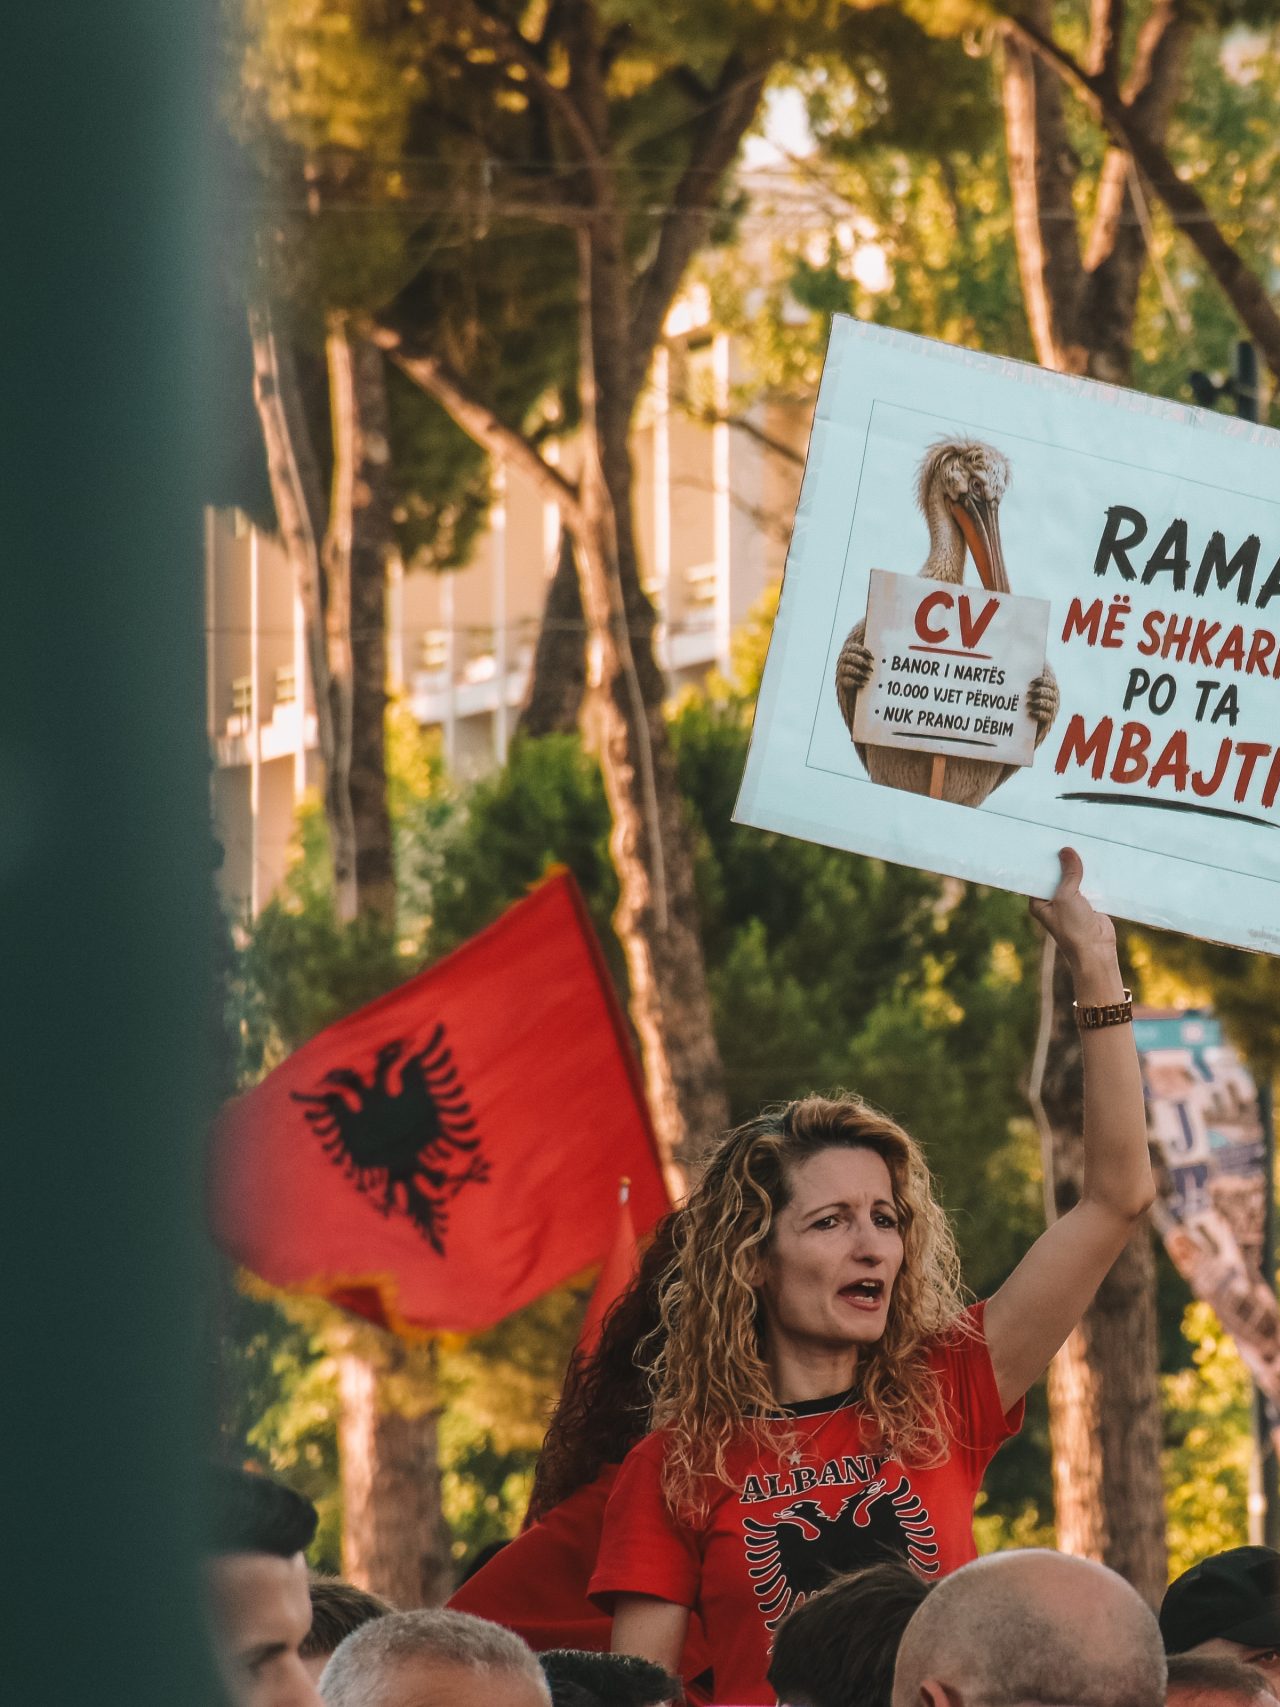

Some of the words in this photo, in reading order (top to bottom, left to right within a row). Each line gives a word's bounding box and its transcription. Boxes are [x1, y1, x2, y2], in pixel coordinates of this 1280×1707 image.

[914, 590, 1001, 650] CV
[1061, 594, 1132, 649] MË
[890, 655, 940, 677] BANOR
[943, 662, 950, 678] I
[953, 663, 1006, 686] NARTËS
[886, 680, 929, 700] 10.000
[933, 687, 964, 706] VJET
[965, 688, 1020, 712] PËRVOJË
[1122, 667, 1178, 716] PO
[1194, 679, 1240, 727] TA
[883, 706, 914, 724] NUK
[916, 710, 971, 731] PRANOJ
[973, 716, 1015, 737] DËBIM
